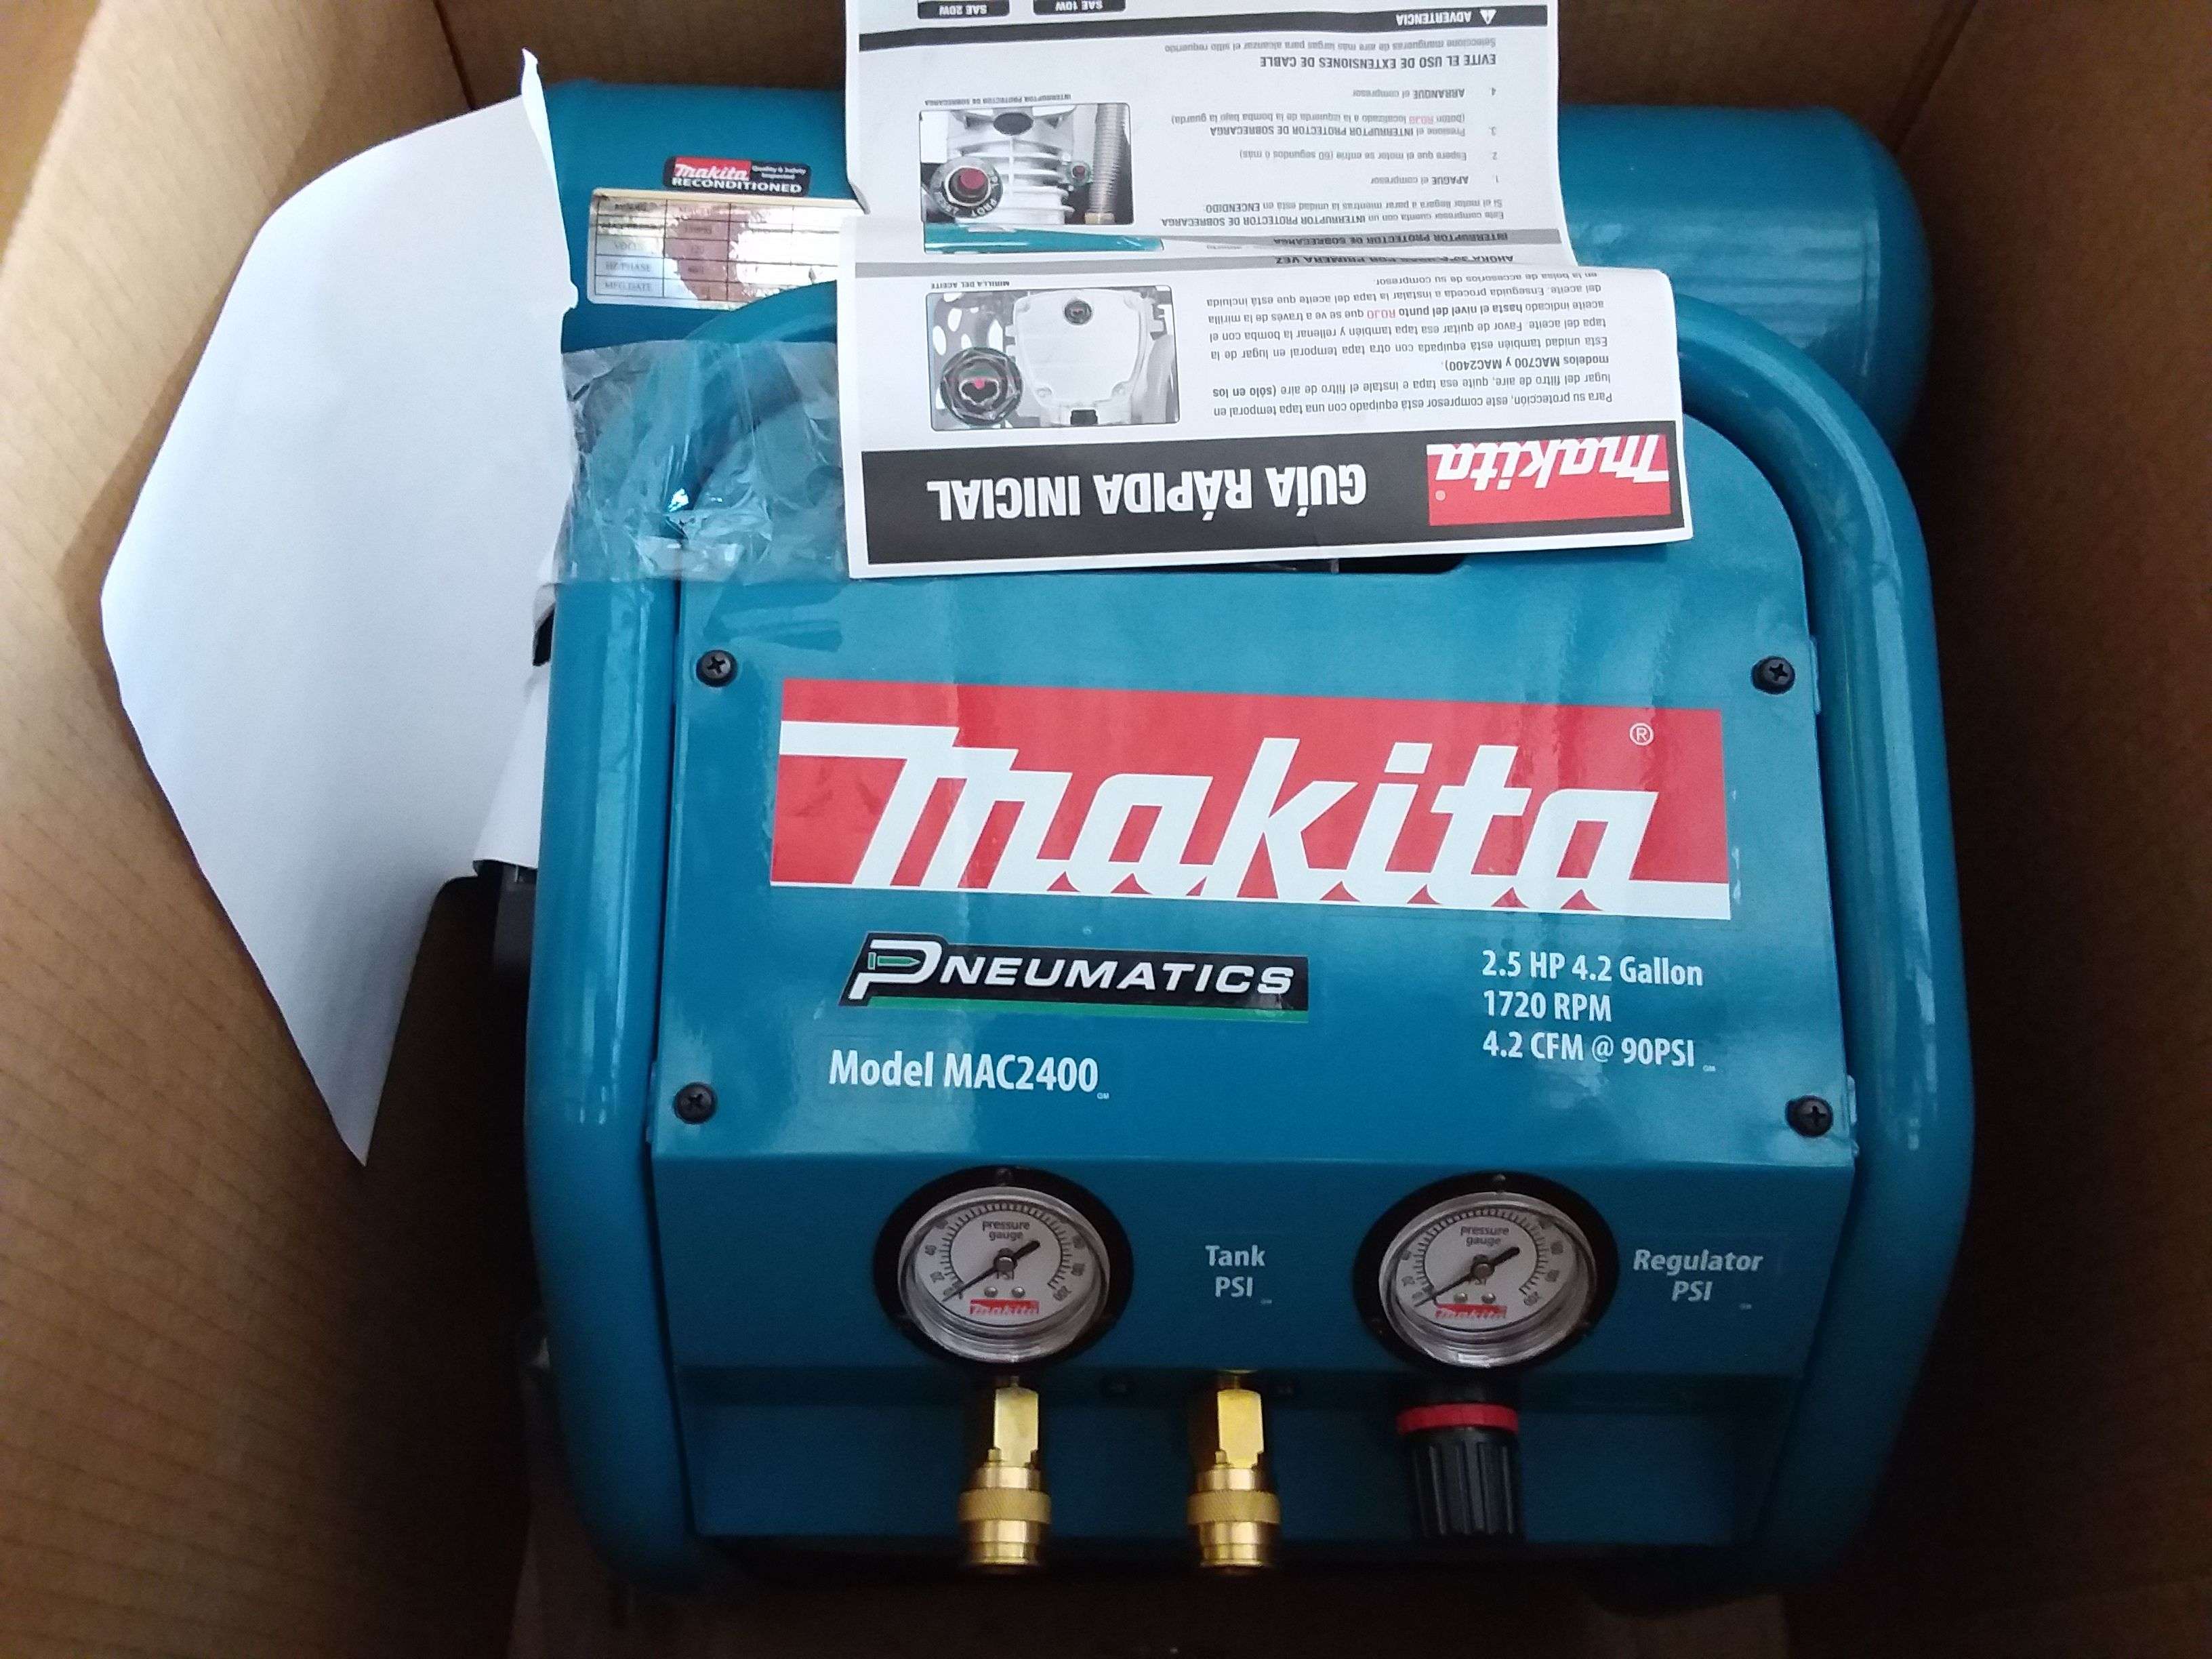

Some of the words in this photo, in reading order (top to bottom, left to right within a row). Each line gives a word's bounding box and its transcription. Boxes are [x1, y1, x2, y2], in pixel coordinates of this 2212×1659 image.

[966, 5, 988, 15] SAE
[1055, 1, 1078, 12] 10W
[1082, 1, 1103, 9] SAE
[1395, 11, 1471, 25] ADVERTENCIA
[1260, 57, 1297, 67] CABLE
[1300, 57, 1315, 67] DE
[1318, 58, 1397, 68] EXTENSIONES
[1400, 58, 1416, 68] DE
[1419, 56, 1443, 67] USO
[1446, 55, 1460, 66] EL
[1463, 54, 1496, 66] EVITE
[1413, 89, 1465, 99] ARRANQUE
[1210, 126, 1275, 136] SOBRECARGA
[1277, 126, 1290, 134] DE
[1292, 126, 1347, 136] PROTECTOR
[1349, 127, 1414, 136] INTERRUPTOR
[672, 177, 802, 193] RECONDITIONED
[1431, 176, 1469, 185] APAGUE
[1228, 218, 1240, 226] DE
[1243, 216, 1298, 225] PROTECTOR
[1300, 216, 1366, 224] INTERRUPTOR
[1443, 287, 1487, 298] proceda
[1490, 287, 1544, 297] Enseguida
[1547, 285, 1582, 294] aceite.
[1585, 285, 1601, 293] del
[1277, 295, 1296, 304] que
[1299, 295, 1331, 304] aceite
[1334, 295, 1350, 304] del
[1353, 293, 1377, 302] tapa
[1379, 293, 1389, 301] la
[1393, 291, 1432, 300] instalar
[1206, 298, 1248, 308] incluida
[1251, 297, 1274, 306] está
[1572, 301, 1604, 310] aceite
[1398, 306, 1429, 317] punto
[1432, 307, 1449, 317] del
[1451, 306, 1477, 316] nivel
[1479, 306, 1490, 314] el
[1492, 304, 1523, 313] hasta
[1525, 302, 1570, 312] indicado
[1255, 314, 1269, 323] de
[1271, 313, 1304, 323] través
[1344, 309, 1364, 318] que
[1366, 309, 1396, 319] ROJO
[1208, 315, 1241, 325] mirilla
[1243, 314, 1253, 324] la
[1582, 317, 1606, 327] tapa
[1395, 324, 1418, 335] tapa
[1443, 322, 1474, 334] quitar
[1477, 323, 1490, 332] de
[1494, 322, 1522, 331] Favor
[1563, 320, 1580, 329] del
[1222, 332, 1242, 340] con
[1244, 331, 1281, 341] bomba
[1283, 331, 1293, 340] la
[1297, 329, 1336, 339] rellenar
[1349, 327, 1392, 336] también
[1210, 333, 1219, 343] el
[1545, 337, 1580, 348] unidad
[1584, 337, 1607, 346] Esta
[1342, 344, 1365, 354] tapa
[1369, 344, 1391, 354] otra
[1418, 342, 1467, 353] equipada
[1470, 341, 1494, 351] está
[1498, 339, 1541, 350] también
[1210, 351, 1220, 361] la
[1224, 351, 1237, 361] de
[1242, 348, 1269, 359] lugar
[1290, 346, 1338, 358] temporal
[1514, 357, 1560, 368] MAC700
[1563, 356, 1609, 366] modelos
[1462, 376, 1489, 388] quite
[1492, 377, 1515, 386] aire,
[1519, 377, 1532, 387] de
[1535, 375, 1561, 386] filtro
[1564, 375, 1580, 385] del
[1585, 372, 1611, 384] lugar
[1321, 384, 1346, 394] filtro
[1349, 384, 1359, 394] el
[1363, 382, 1399, 393] instale
[1412, 379, 1436, 390] tapa
[1439, 380, 1458, 388] esa
[1212, 389, 1229, 398] los
[1249, 385, 1277, 397] (sólo
[1280, 386, 1300, 396] aire
[1305, 385, 1317, 396] de
[1427, 396, 1483, 407] compresor
[1486, 397, 1509, 407] este
[1511, 392, 1570, 406] protección,
[1573, 393, 1586, 401] su
[1588, 392, 1612, 402] Para
[1279, 403, 1303, 414] tapa
[1305, 404, 1325, 412] una
[1349, 399, 1399, 413] equipado
[1401, 400, 1425, 411] está
[1229, 405, 1277, 417] temporal
[1093, 468, 1252, 520] RÁPIDA
[1265, 464, 1366, 516] GUÍA
[926, 475, 1080, 520] INICIAL
[848, 939, 1294, 1000] PNEUMATICS
[1482, 950, 1521, 977] 2.5
[1530, 951, 1565, 979] HP
[1572, 954, 1612, 981] 4.2
[1620, 956, 1703, 986] Gallon
[1483, 990, 1547, 1019] 1720
[1554, 992, 1612, 1021] RPM
[1483, 1030, 1523, 1059] 4.2
[1530, 1032, 1584, 1061] CFM
[1592, 1034, 1614, 1063] @
[1621, 1037, 1694, 1067] 90PSI
[830, 1050, 933, 1086] Model
[944, 1052, 1099, 1092] MAC2400
[982, 1221, 1030, 1232] pressure
[1460, 1225, 1510, 1236] pressure
[989, 1231, 1023, 1242] gauge
[1466, 1236, 1502, 1246] gauge
[1205, 1244, 1265, 1267] Tank
[1633, 1248, 1763, 1276] Regulator
[1215, 1276, 1253, 1297] PSI
[1671, 1280, 1713, 1302] PSI
